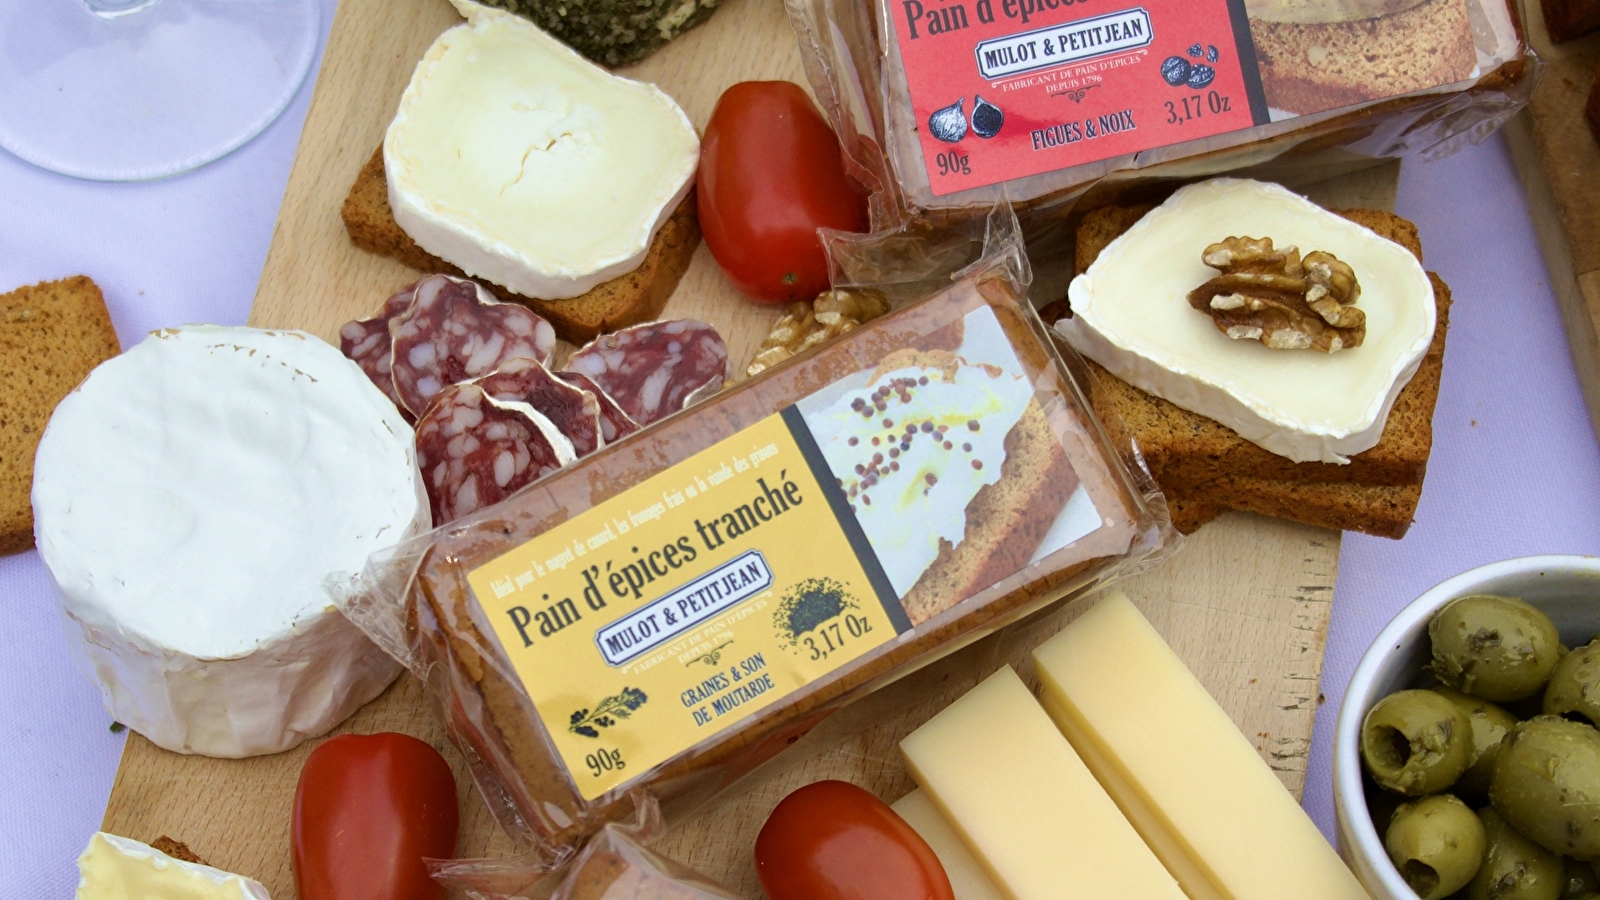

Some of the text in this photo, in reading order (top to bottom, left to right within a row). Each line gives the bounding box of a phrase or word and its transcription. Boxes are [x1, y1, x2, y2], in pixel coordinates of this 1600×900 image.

[903, 0, 970, 40] Pain
[984, 18, 1143, 70] MULOT & PETITJEAN
[1002, 55, 1142, 92] FABRICANT DE PAIN D'ÉPICES
[1045, 74, 1103, 94] DEPUIS 1796
[1030, 109, 1137, 151] FIGUES & NOIX
[1164, 90, 1232, 126] 3,17 Oz
[936, 151, 972, 176] 90g
[515, 570, 535, 591] pour
[532, 561, 546, 577] le
[572, 539, 587, 557] de
[613, 518, 630, 535] les
[663, 488, 685, 509] frais
[694, 476, 708, 493] la
[732, 456, 750, 473] des
[506, 468, 803, 648] Pain d'épices tranché
[605, 561, 763, 656] MULOT & PETITJEAN
[633, 641, 689, 675] FABRICANT
[689, 634, 703, 647] DE
[703, 622, 727, 638] PAIN
[677, 630, 735, 664] DEPUIS 1796
[803, 614, 873, 662] 3,17 Oz
[680, 652, 767, 709] GRAINES & SON
[692, 673, 775, 728] DE MOUTARDE
[585, 746, 626, 778] 90g
